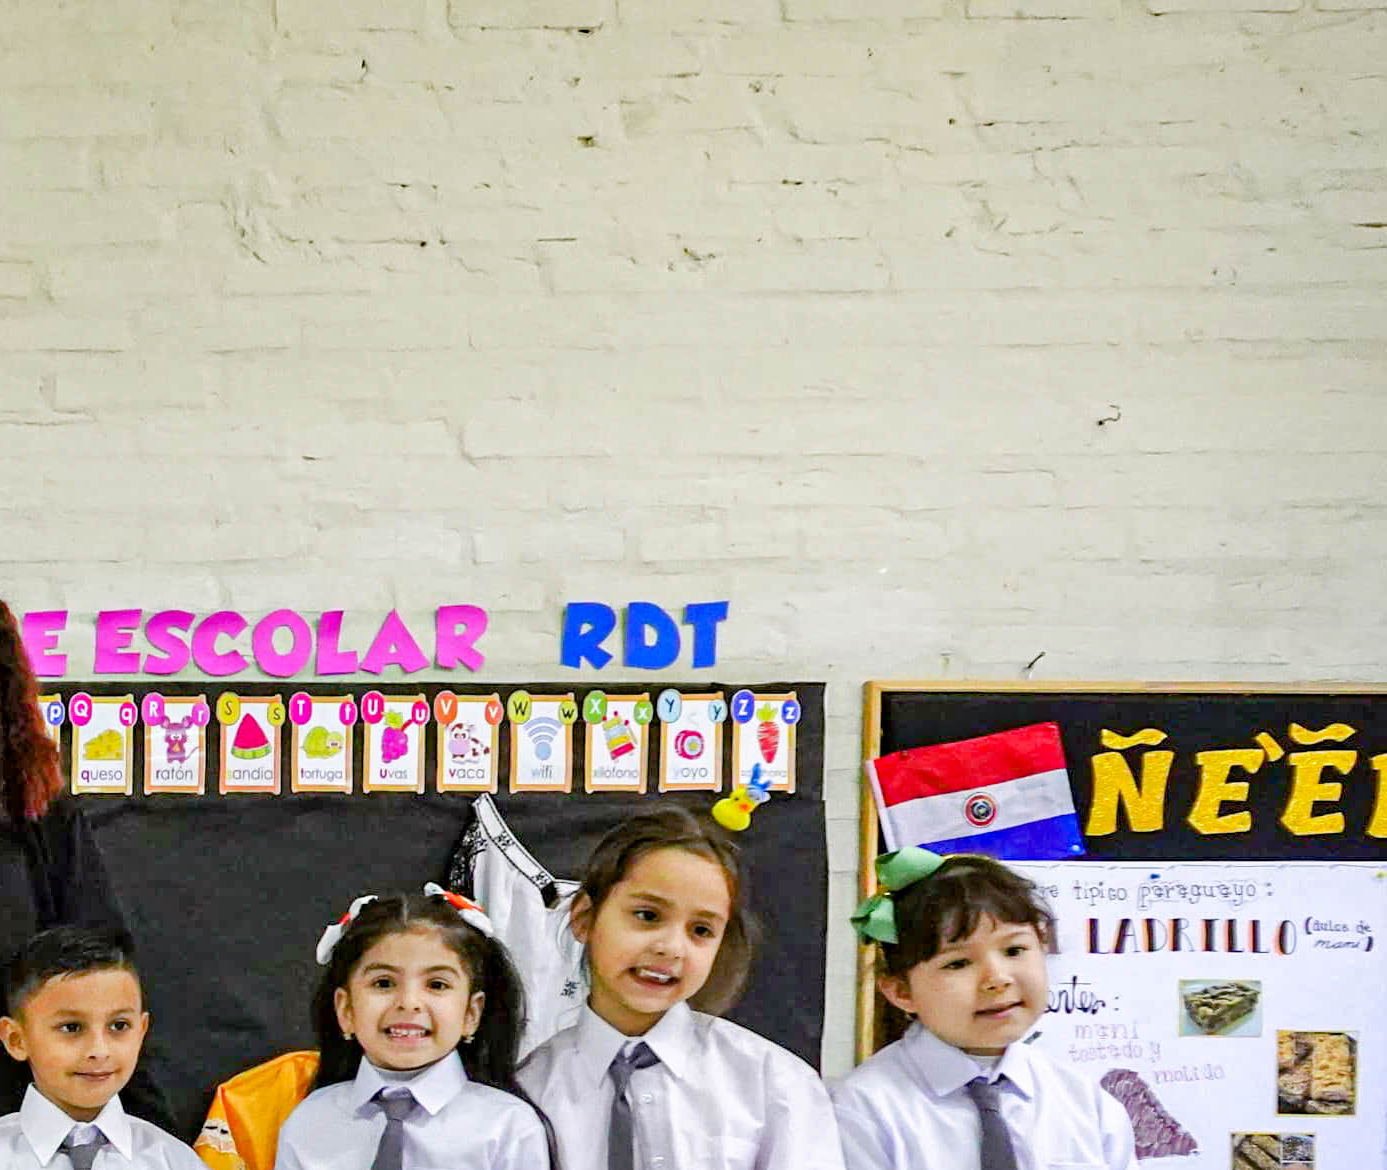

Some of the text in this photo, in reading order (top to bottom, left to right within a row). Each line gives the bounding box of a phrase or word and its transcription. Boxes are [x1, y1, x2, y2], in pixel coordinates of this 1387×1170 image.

[94, 604, 487, 677] ESCOLAR
[560, 601, 731, 672] RDT
[74, 698, 132, 722] Q q
[149, 702, 158, 717] R
[367, 699, 425, 721] U u
[441, 698, 452, 714] V
[513, 703, 574, 719] W w
[589, 698, 601, 713] X
[665, 697, 722, 721] Y y
[738, 699, 748, 716] Z
[81, 769, 122, 784] queso
[300, 768, 343, 781] tortuga
[379, 768, 408, 780] uvas
[448, 768, 485, 780] vaca
[531, 764, 553, 779] wifi
[1086, 917, 1297, 956] LADRILLO
